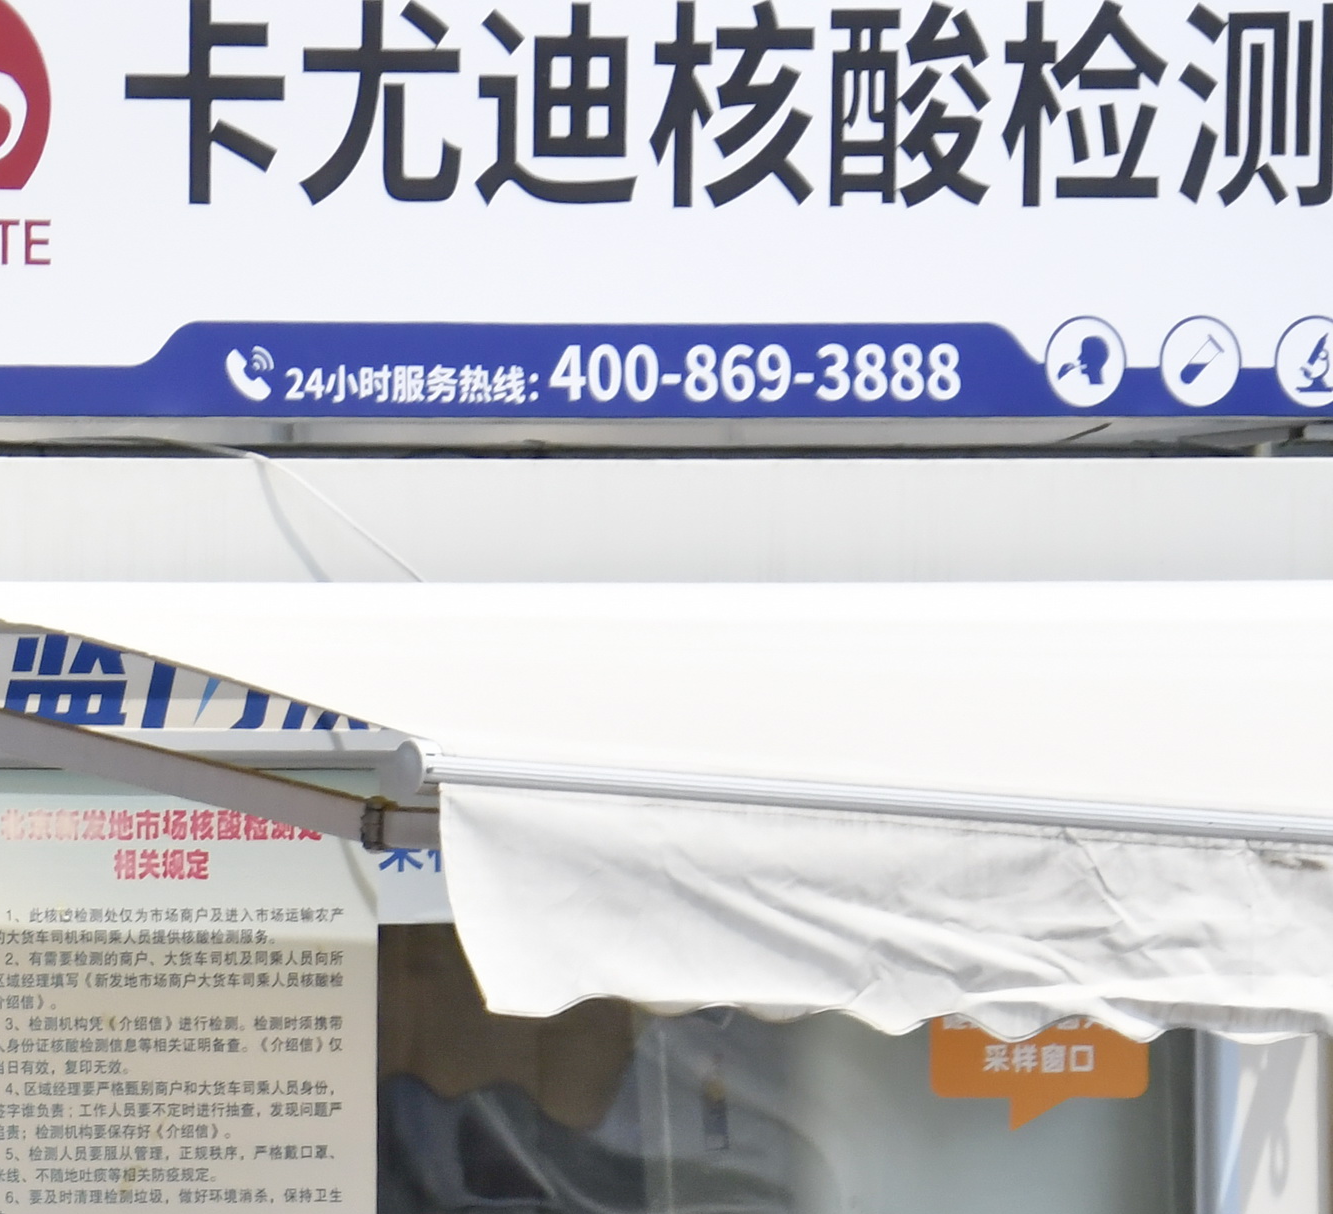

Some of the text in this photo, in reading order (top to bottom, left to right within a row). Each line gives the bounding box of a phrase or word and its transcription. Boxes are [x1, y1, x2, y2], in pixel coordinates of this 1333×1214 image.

[123, 0, 1333, 206] 卡尤迪核酸检测
[549, 343, 962, 402] 400-869-3888
[114, 849, 210, 880] 相关规定
[983, 1044, 1094, 1072] 采样窗口
